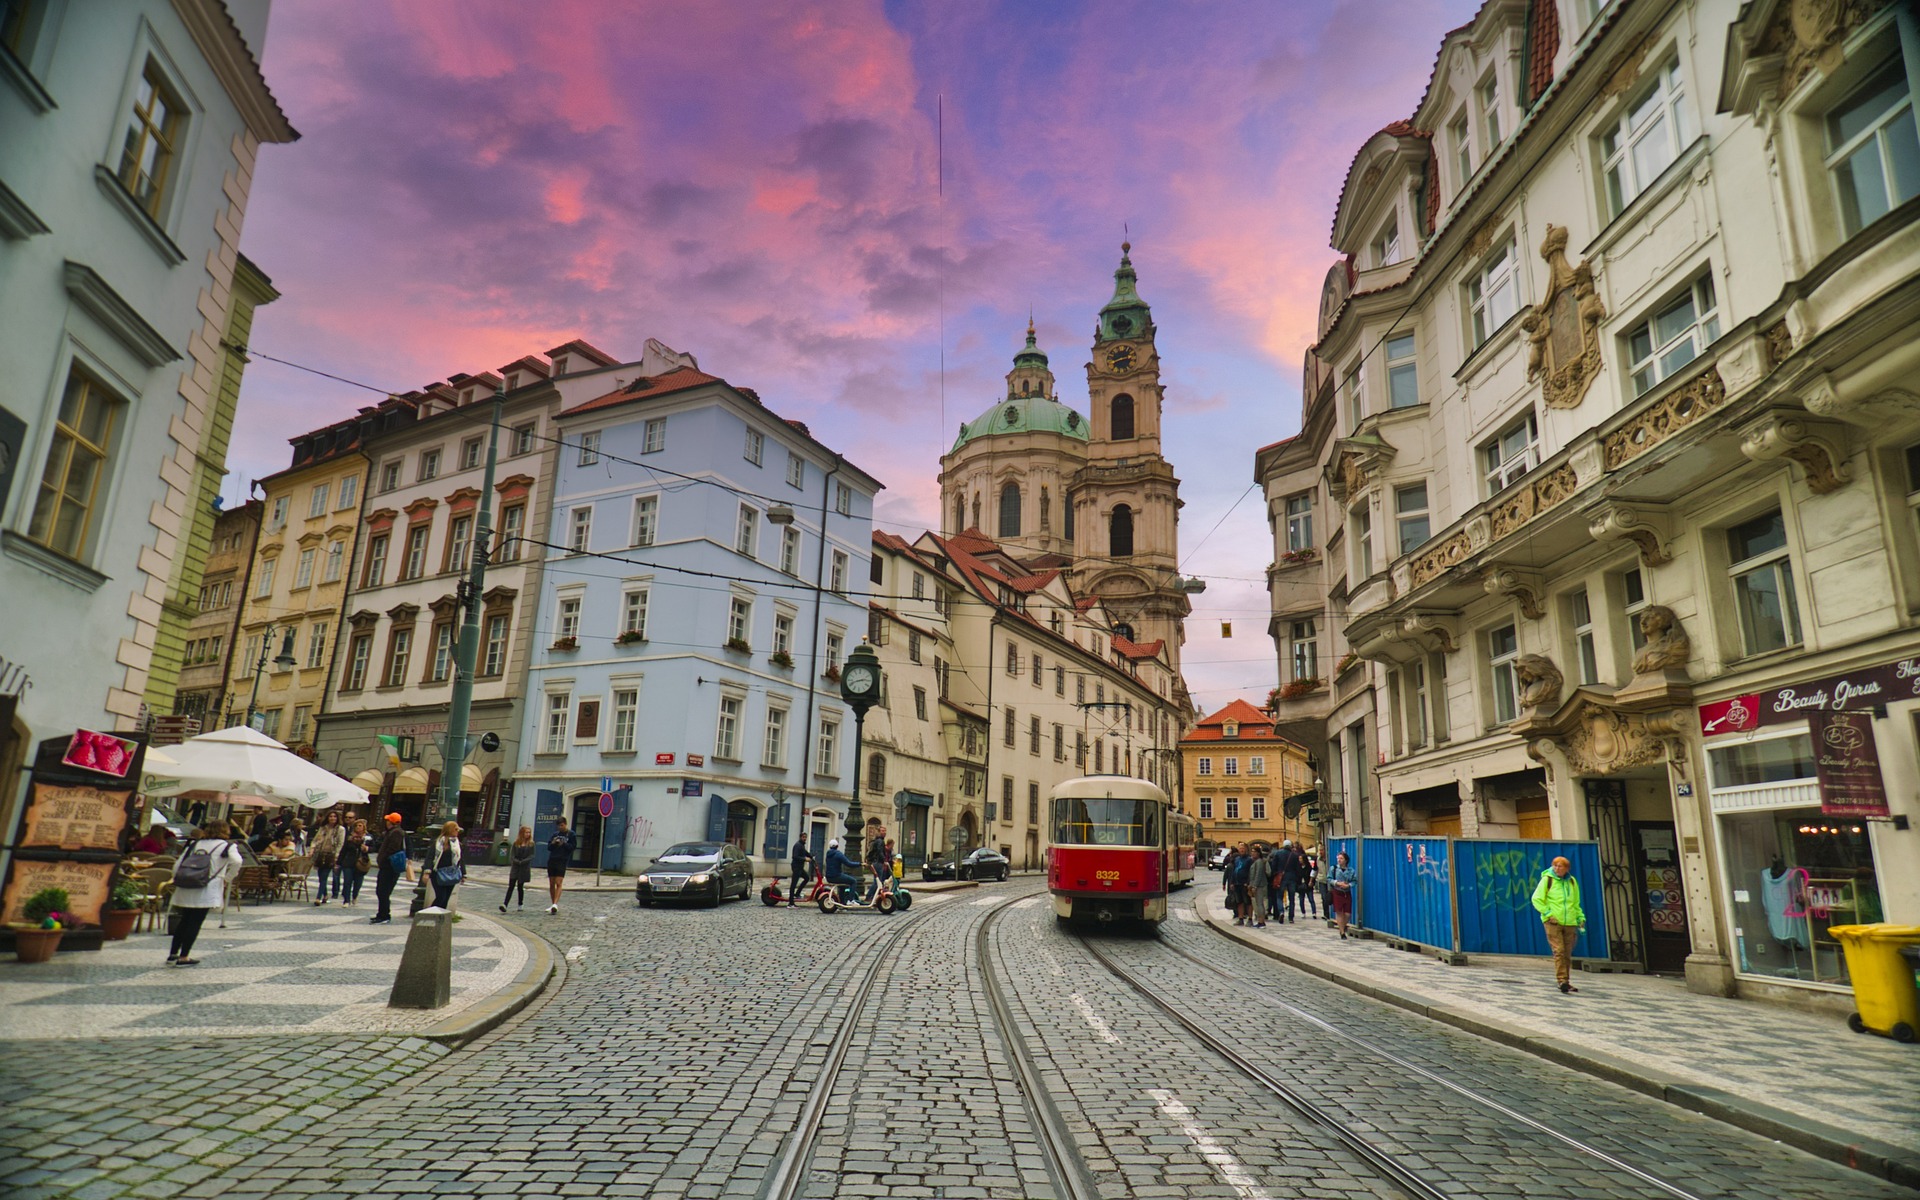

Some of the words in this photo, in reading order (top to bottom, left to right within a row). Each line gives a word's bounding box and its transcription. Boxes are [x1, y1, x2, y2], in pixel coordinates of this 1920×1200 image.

[1773, 688, 1828, 712] Beauty
[1832, 680, 1882, 710] Gurus
[1819, 754, 1850, 769] Beauty
[1678, 785, 1689, 794] 24
[1098, 831, 1116, 843] 20
[1096, 870, 1120, 880] 8322
